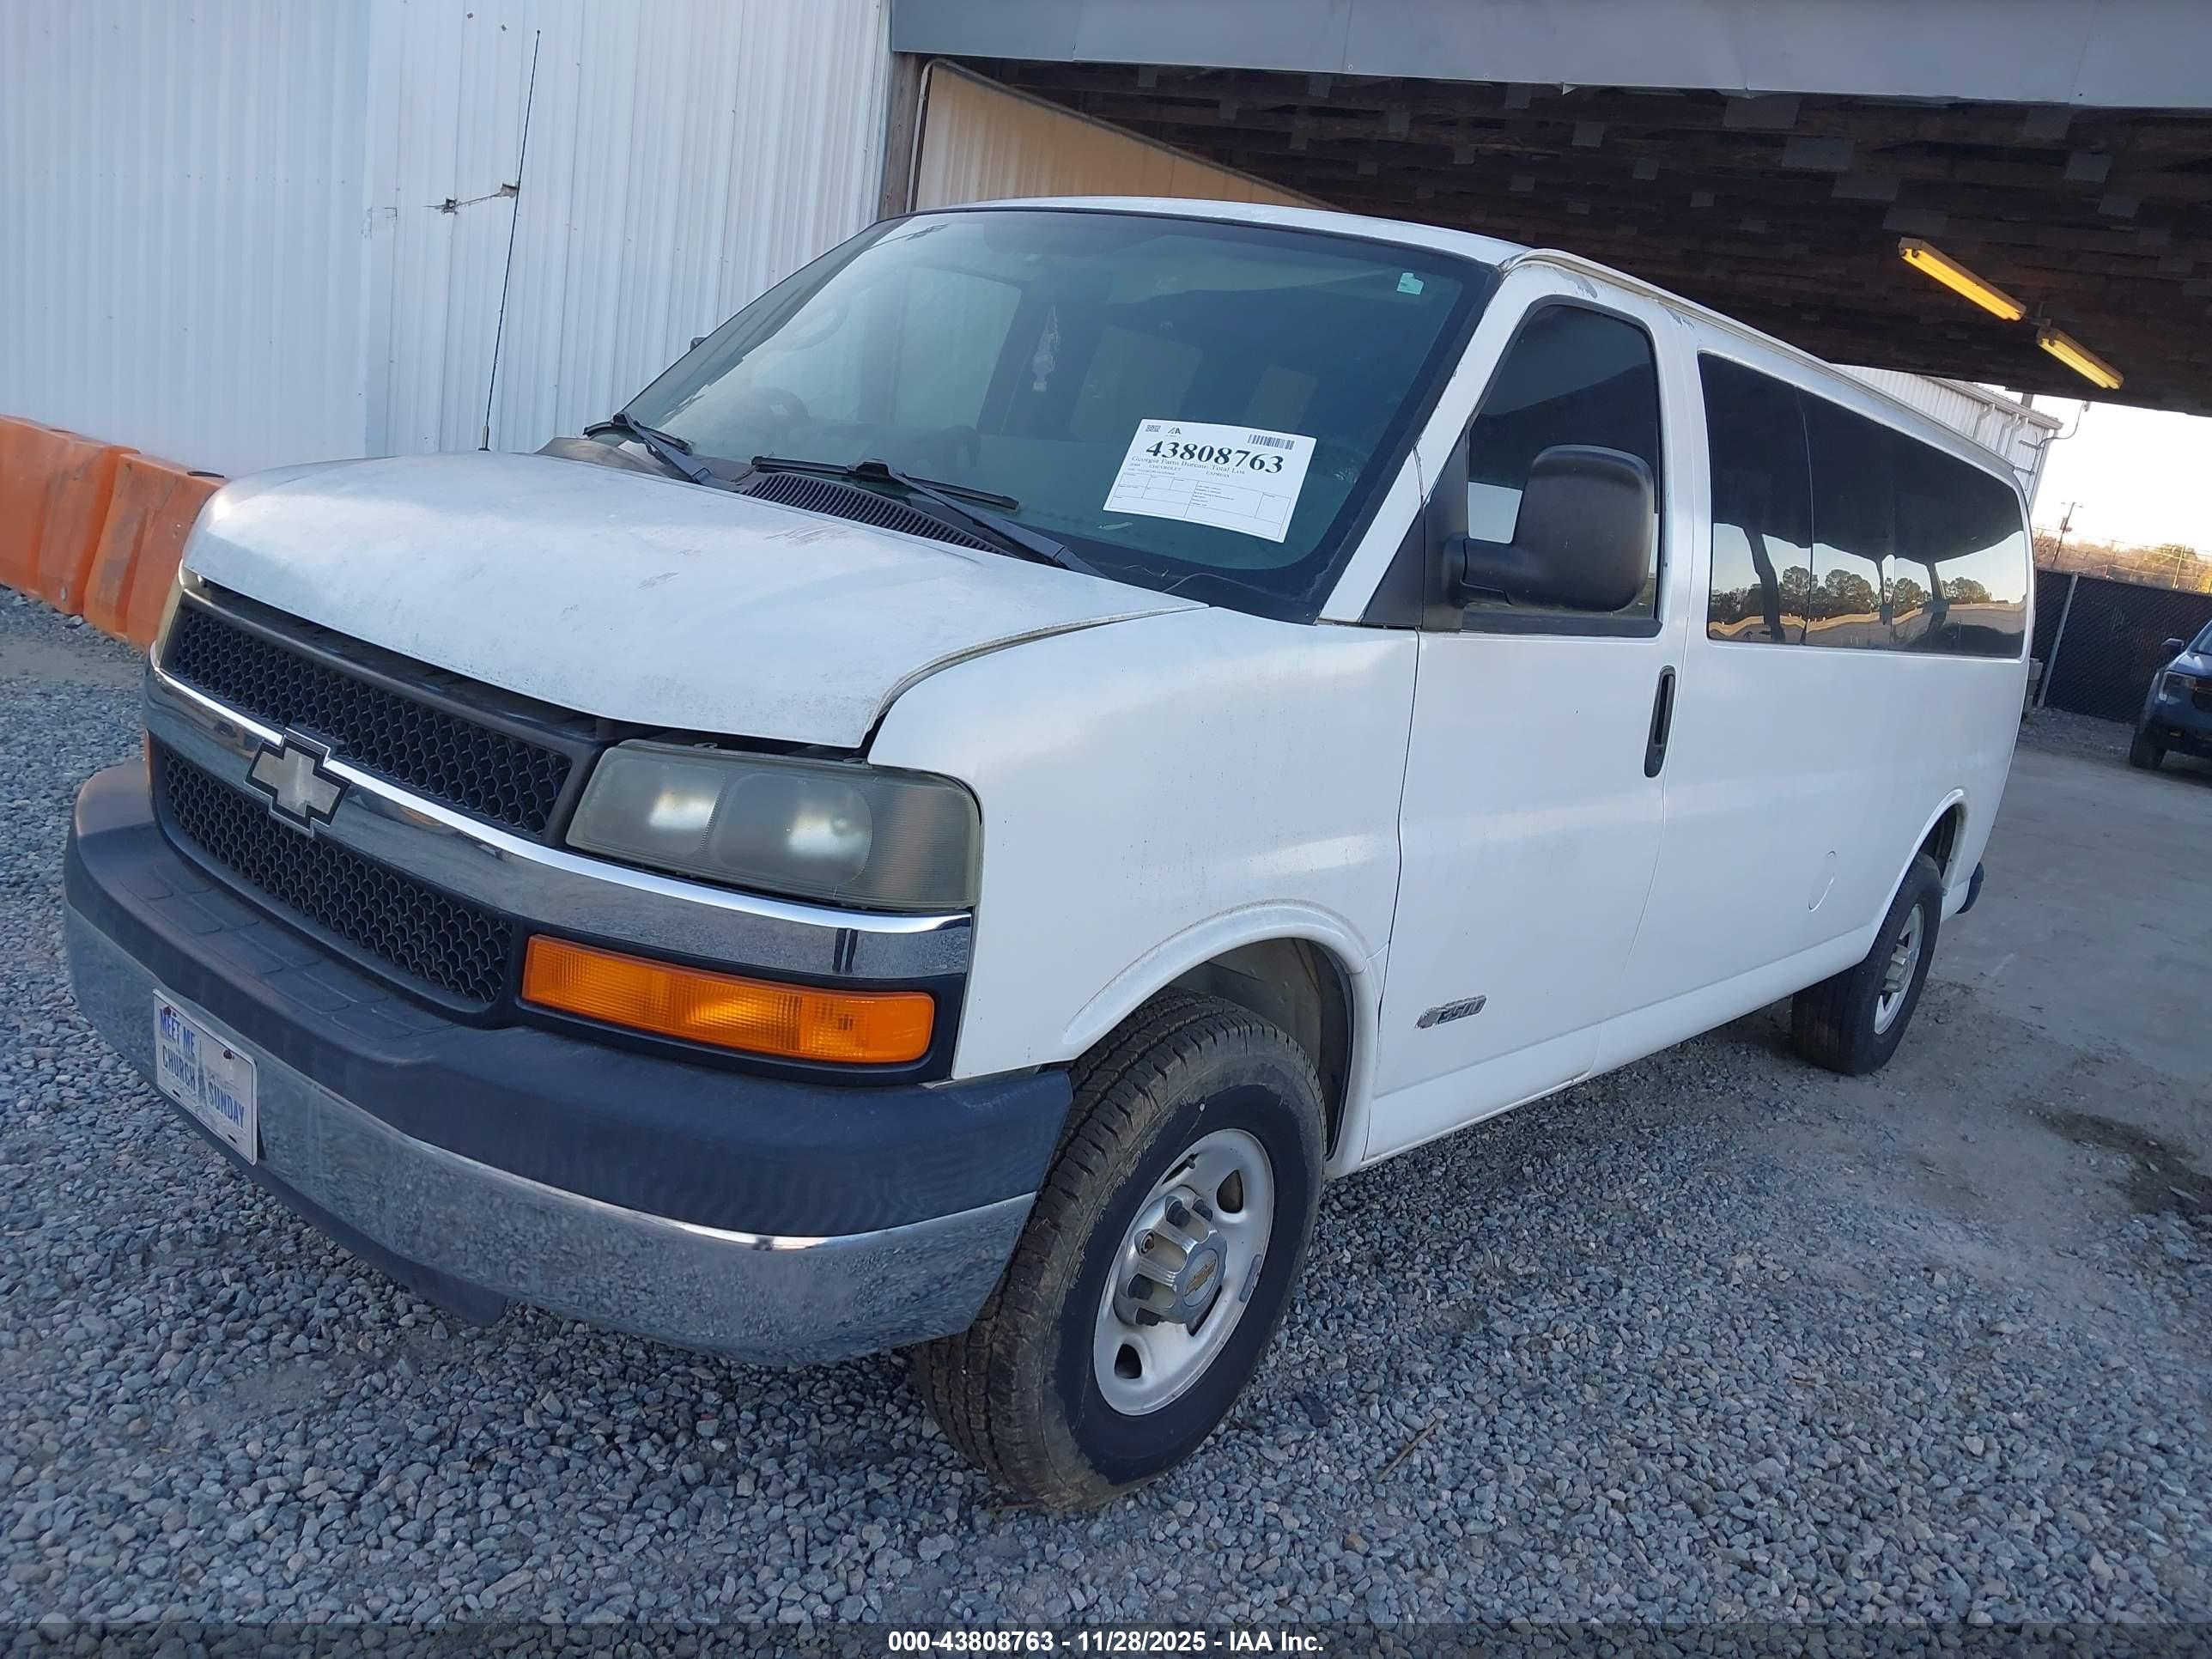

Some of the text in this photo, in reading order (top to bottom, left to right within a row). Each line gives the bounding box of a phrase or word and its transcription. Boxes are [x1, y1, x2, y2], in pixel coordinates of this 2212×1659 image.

[1132, 455, 1159, 465] Georgia
[1146, 440, 1285, 474] 43808763
[160, 1007, 196, 1057] MEET ME
[162, 1044, 245, 1129] CHURCH SUNDAY
